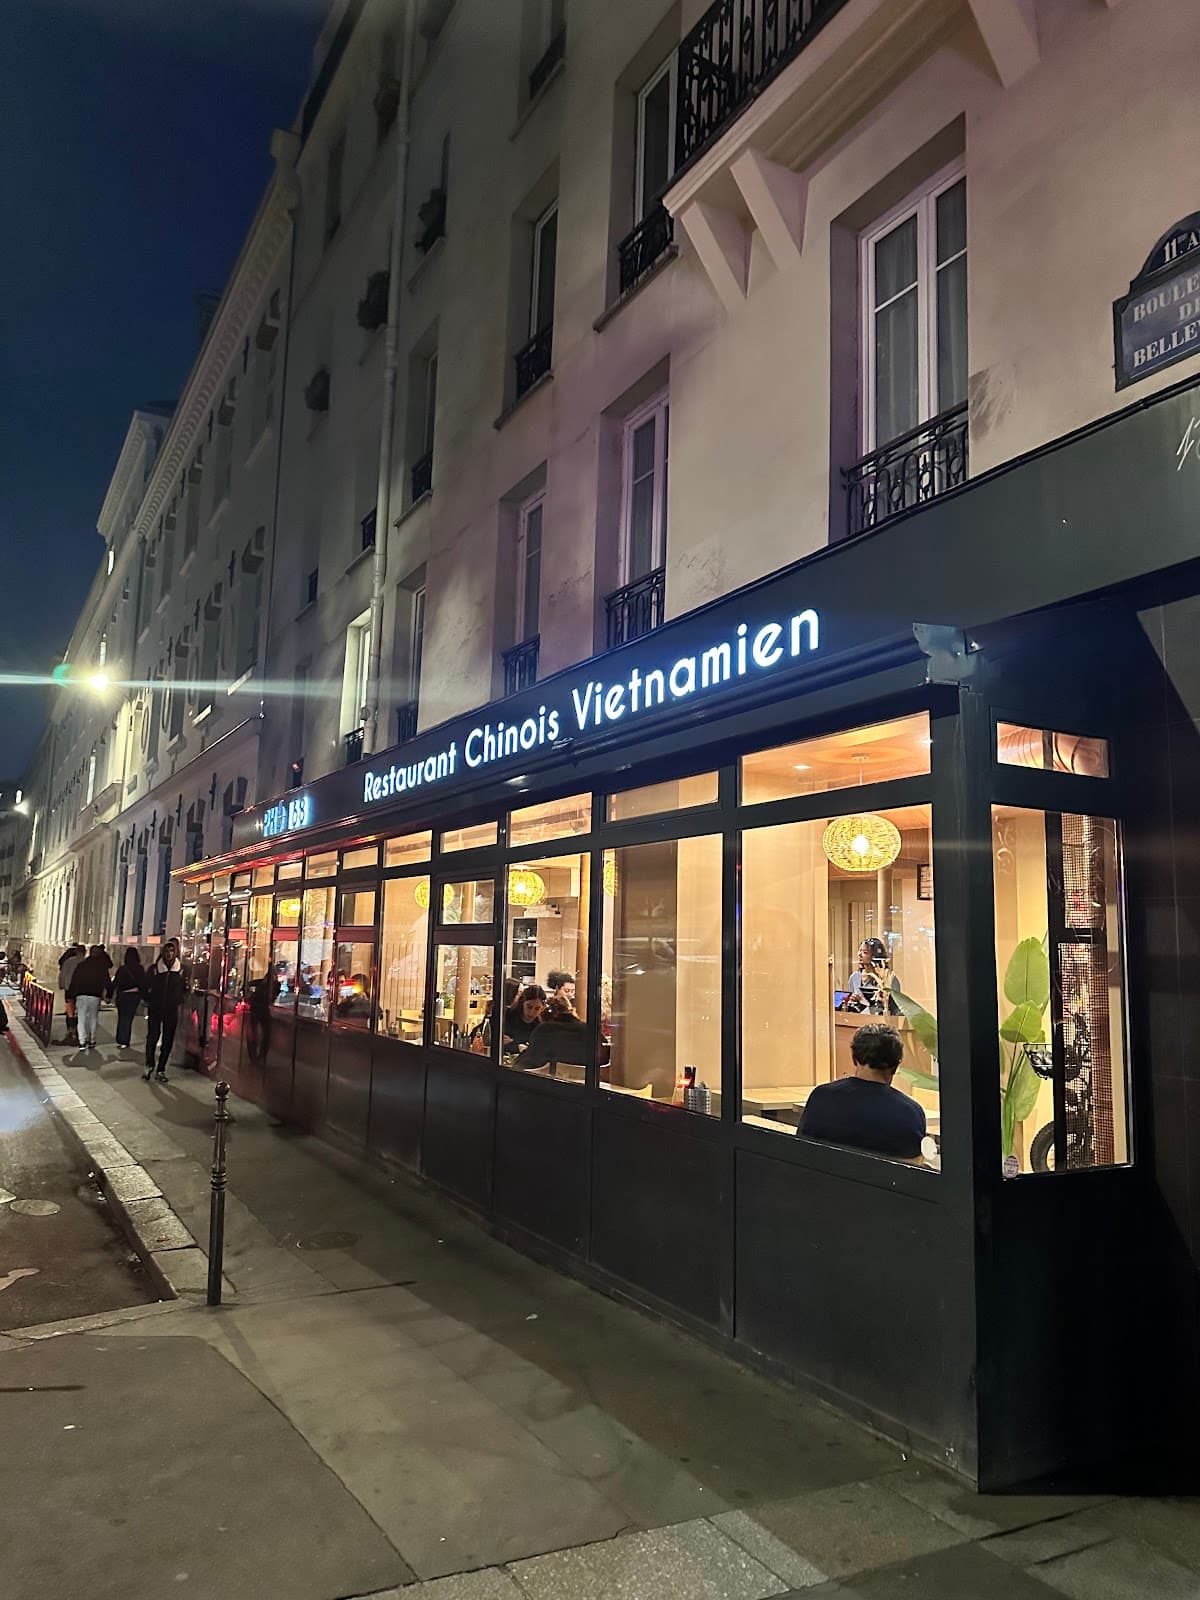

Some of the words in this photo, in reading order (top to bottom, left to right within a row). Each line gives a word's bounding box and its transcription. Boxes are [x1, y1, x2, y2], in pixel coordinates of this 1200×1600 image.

[1133, 272, 1200, 323] BOULE
[1133, 320, 1200, 368] BELLE
[363, 741, 457, 803] Restaurant
[464, 705, 559, 768] Chinois
[572, 608, 819, 731] Vietnamien
